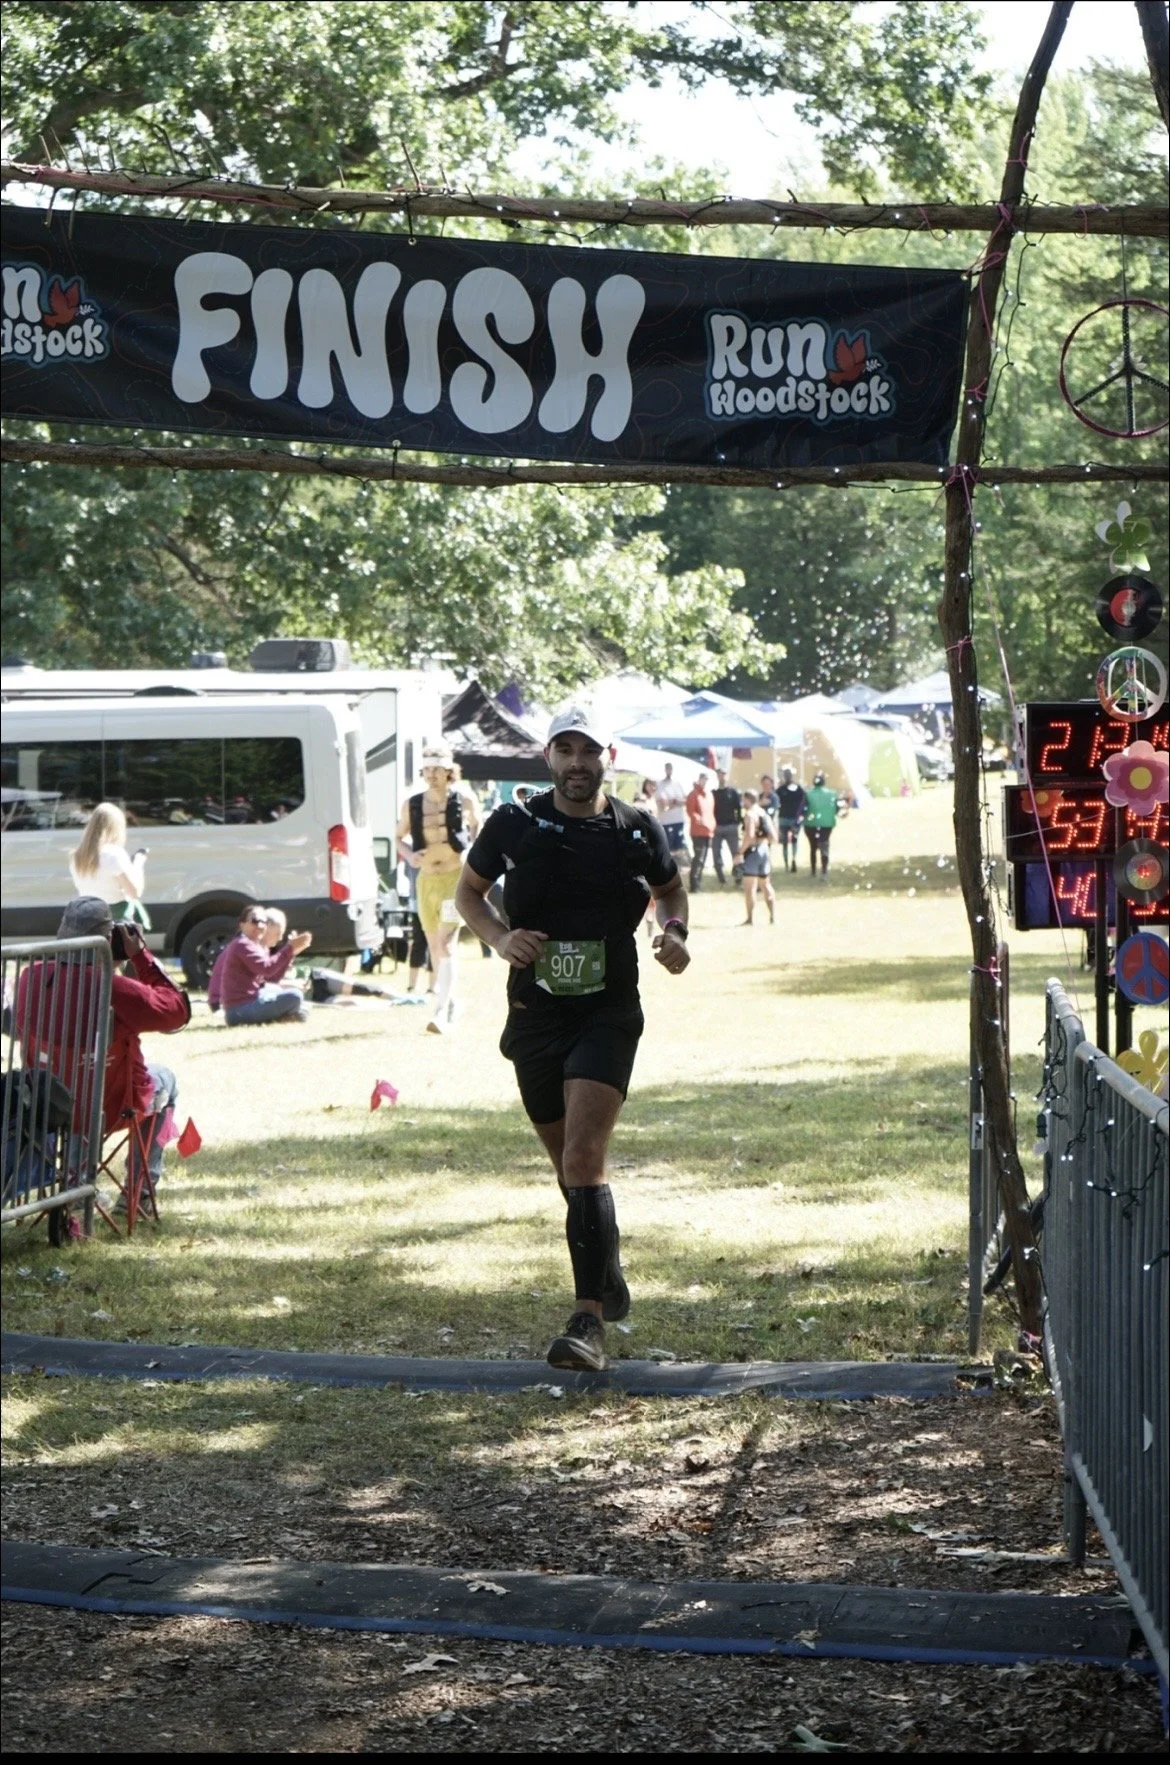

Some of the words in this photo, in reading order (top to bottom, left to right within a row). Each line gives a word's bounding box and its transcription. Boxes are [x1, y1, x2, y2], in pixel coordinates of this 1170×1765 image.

[172, 252, 645, 442] FINISH
[710, 314, 827, 380] Run
[709, 375, 891, 420] Woodstock
[550, 955, 586, 978] 907
